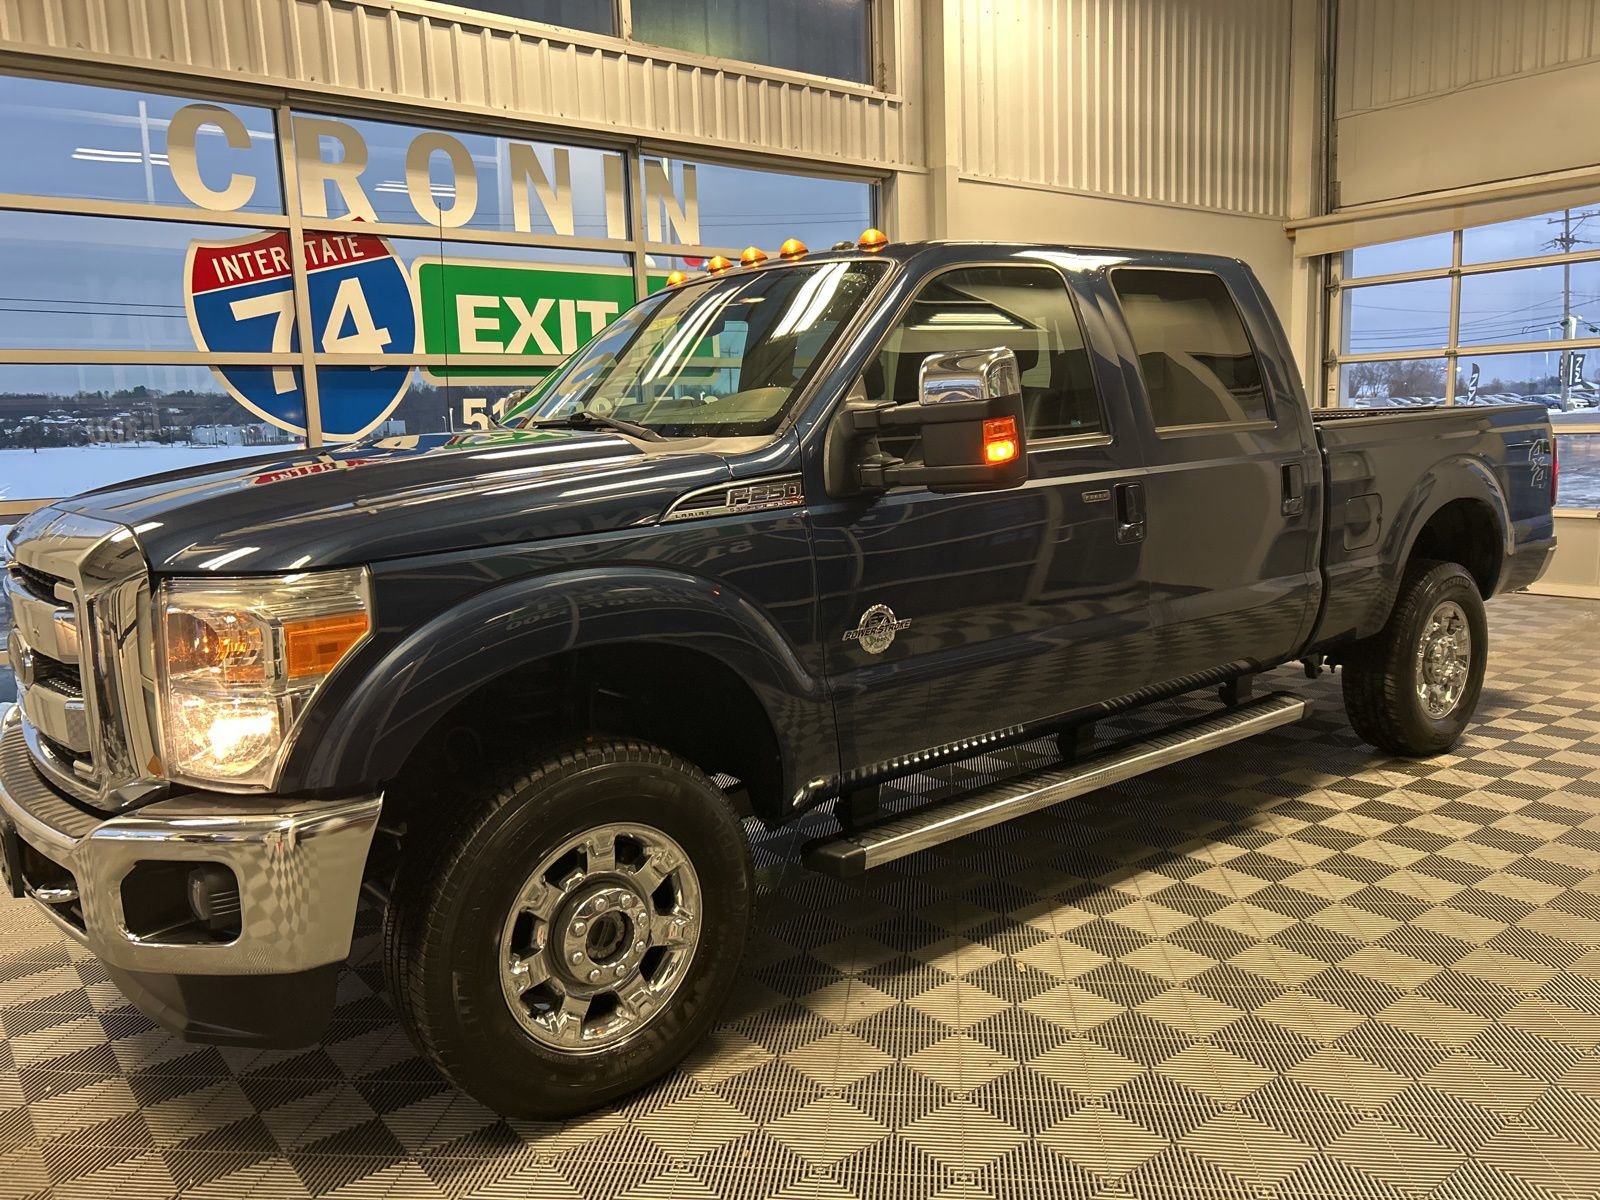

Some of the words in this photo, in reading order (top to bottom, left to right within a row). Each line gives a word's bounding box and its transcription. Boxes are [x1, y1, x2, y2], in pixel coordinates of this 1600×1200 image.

[167, 103, 700, 246] CRONIN
[211, 234, 365, 284] INTERTATE
[228, 276, 393, 395] 74
[455, 294, 619, 355] EXIT
[675, 510, 711, 519] LARIAT
